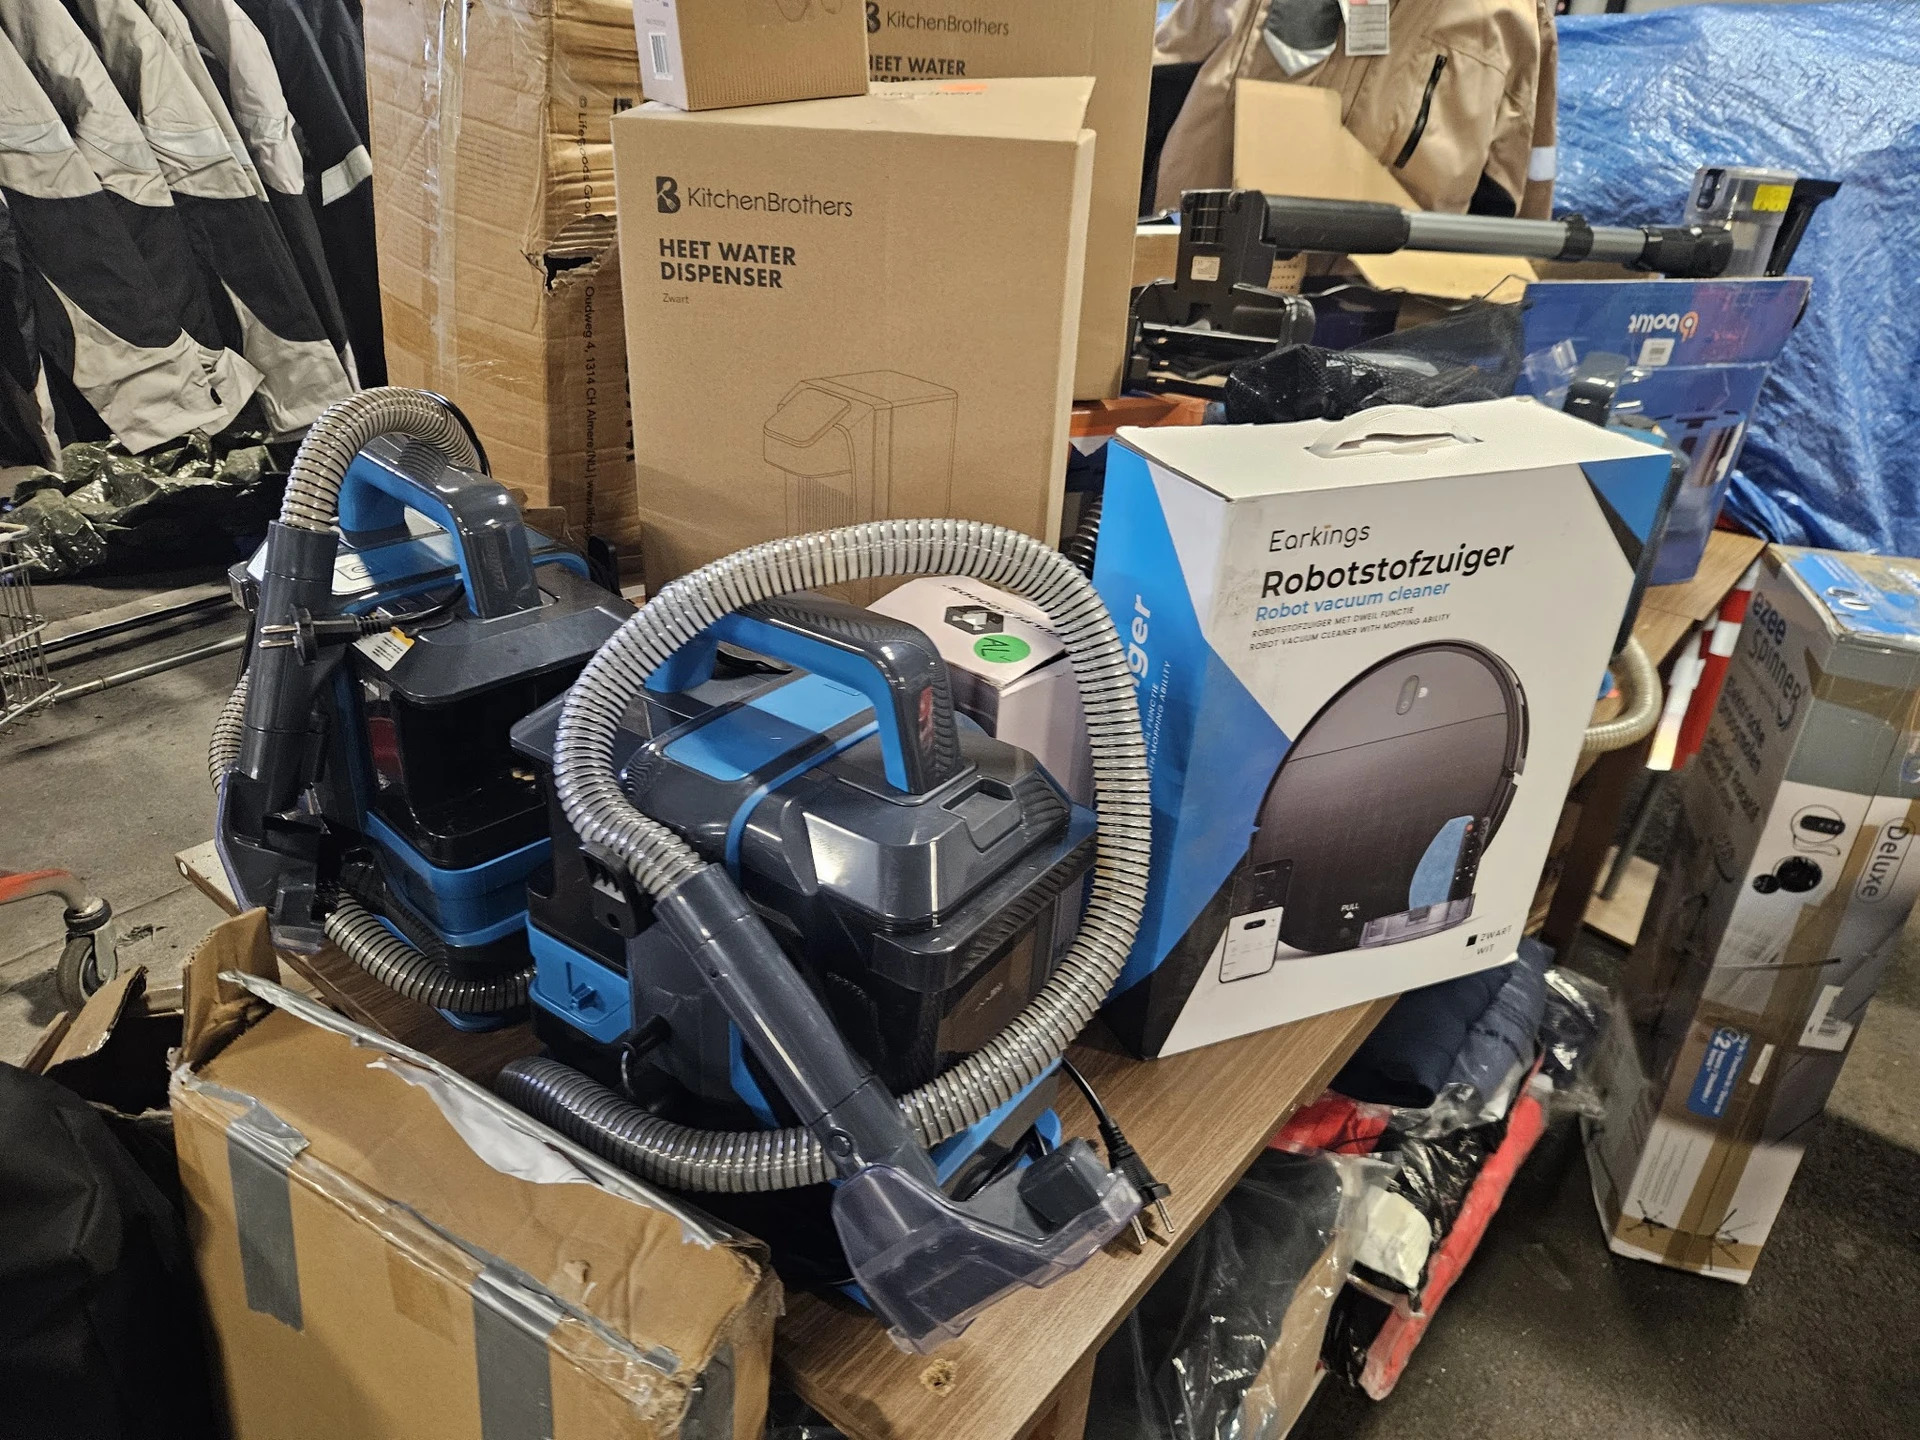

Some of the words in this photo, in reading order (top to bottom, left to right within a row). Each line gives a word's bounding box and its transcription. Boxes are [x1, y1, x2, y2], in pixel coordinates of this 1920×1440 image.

[887, 11, 1009, 36] KitchenBrothers
[908, 57, 966, 76] WATER
[687, 187, 853, 217] KitchenBrothers
[659, 238, 711, 260] HEET
[717, 242, 796, 266] WATER
[660, 262, 783, 288] DISPENSER
[584, 286, 596, 338] Oudweg
[662, 292, 690, 304] Zwart
[585, 341, 595, 353] 4,
[585, 357, 595, 385] 1314
[585, 387, 596, 406] CH
[586, 408, 596, 449] Almere
[1268, 524, 1371, 552] Earkings
[1261, 543, 1515, 598] Robotstofzuiger
[1254, 600, 1309, 622] Robot
[1313, 590, 1383, 613] vacuum
[1388, 581, 1451, 602] cleaner
[1249, 638, 1279, 651] ROBOT
[1281, 632, 1319, 646] VACUUM
[1320, 627, 1357, 640] CLEANER
[1359, 623, 1381, 634] WITH
[1383, 617, 1420, 631] MOPPING
[1421, 612, 1452, 625] ABILITY
[1251, 618, 1332, 638] ROBOTSTOFZUIGER
[1334, 615, 1352, 625] MET
[1353, 611, 1378, 622] DWEIL
[1380, 606, 1415, 619] FUNCTIE
[1752, 591, 1786, 645] ezee
[1152, 705, 1165, 755] MOPPING
[1160, 661, 1172, 702] ABILITY
[1861, 826, 1909, 897] Deluxe
[1340, 902, 1360, 912] PULL
[1479, 924, 1513, 942] ZWART
[1476, 943, 1494, 956] WIT
